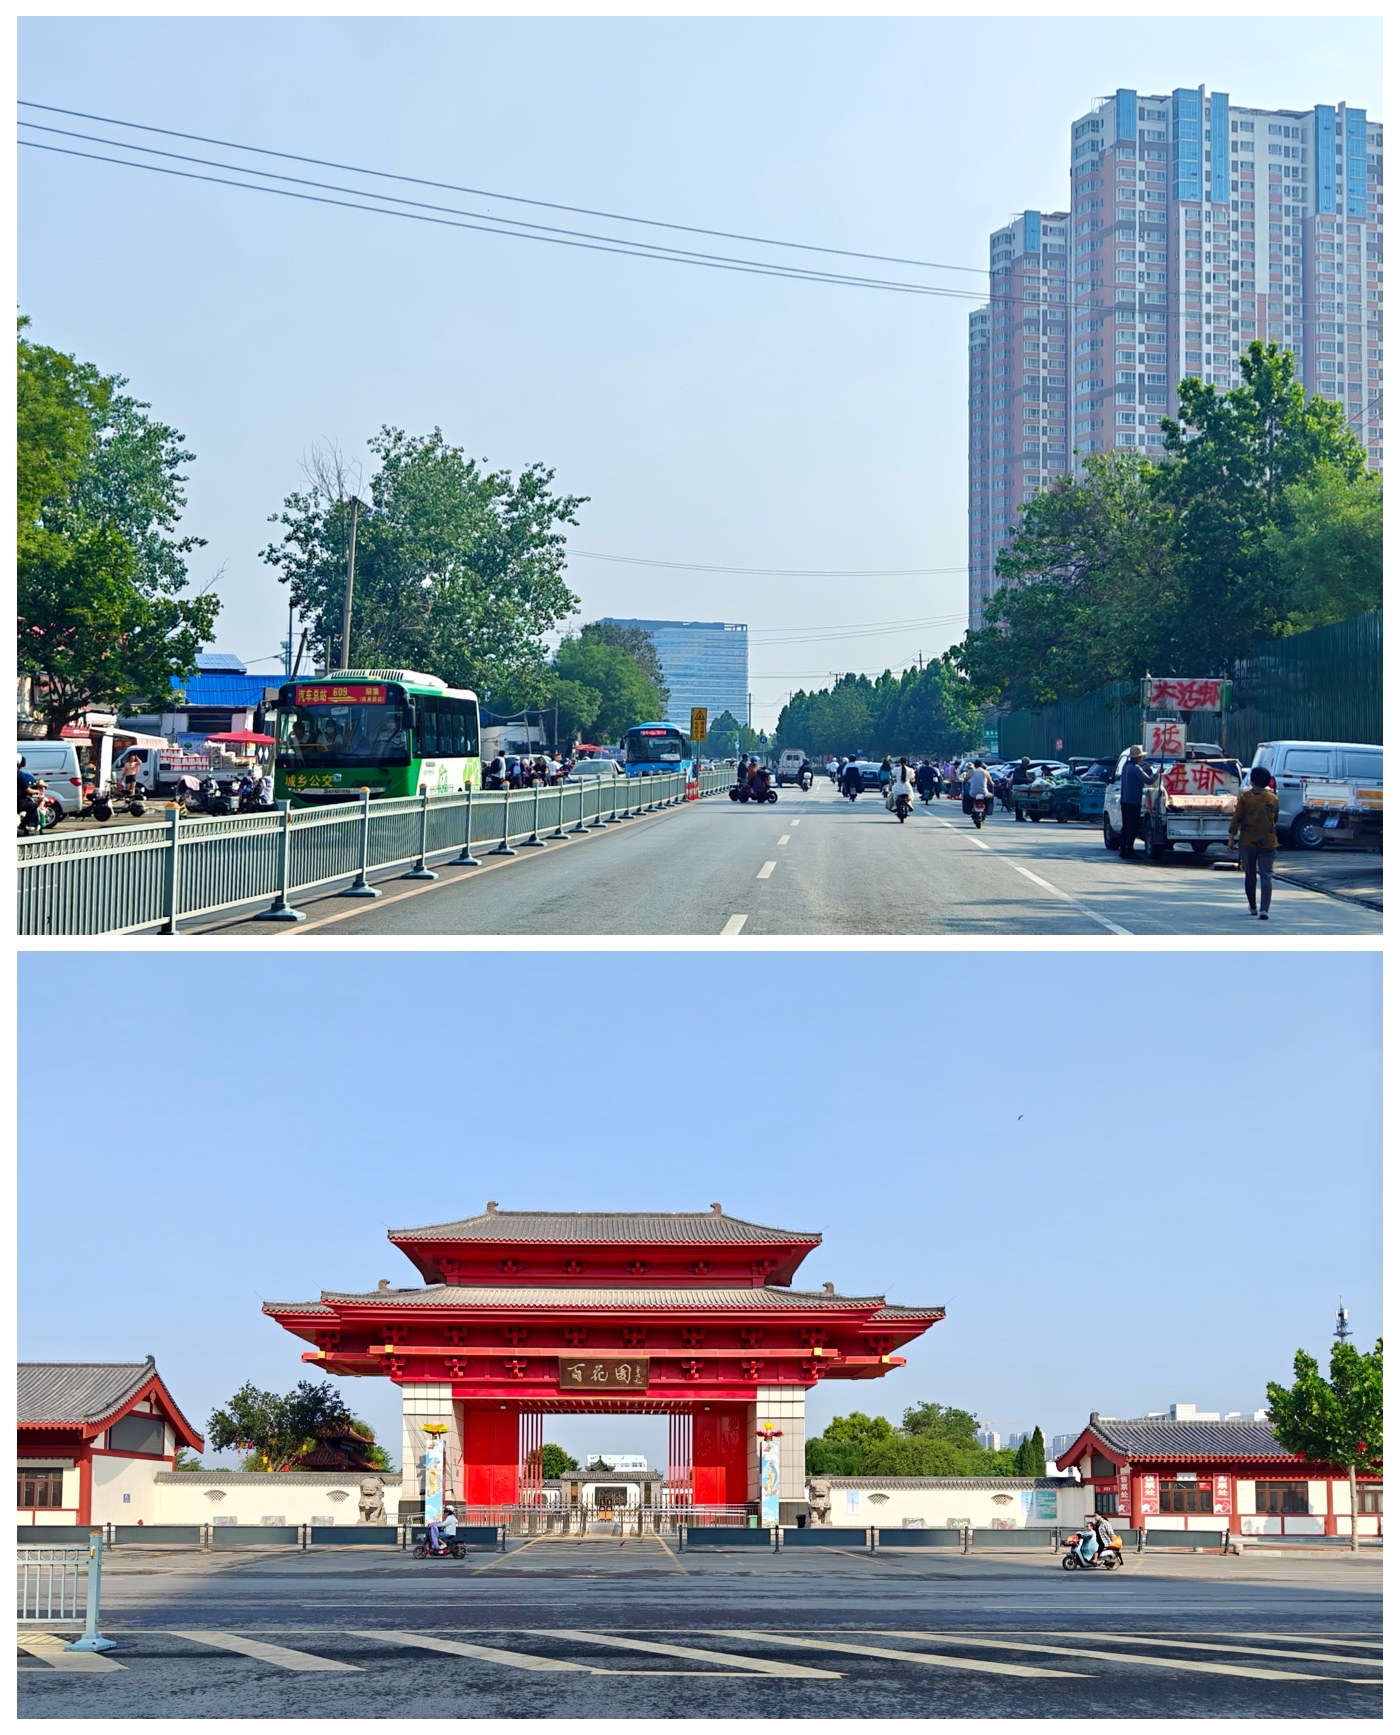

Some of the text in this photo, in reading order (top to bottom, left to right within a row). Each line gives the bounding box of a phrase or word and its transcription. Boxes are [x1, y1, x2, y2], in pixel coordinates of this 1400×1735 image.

[297, 688, 328, 703] 汽车总站
[332, 687, 348, 697] 609
[1151, 680, 1220, 710] 大活虾
[1151, 725, 1182, 754] 活
[285, 774, 334, 787] 城乡公交
[1120, 1475, 1129, 1499] 售票处
[1144, 1475, 1155, 1496] 售票处
[1217, 1475, 1229, 1497] 售票处
